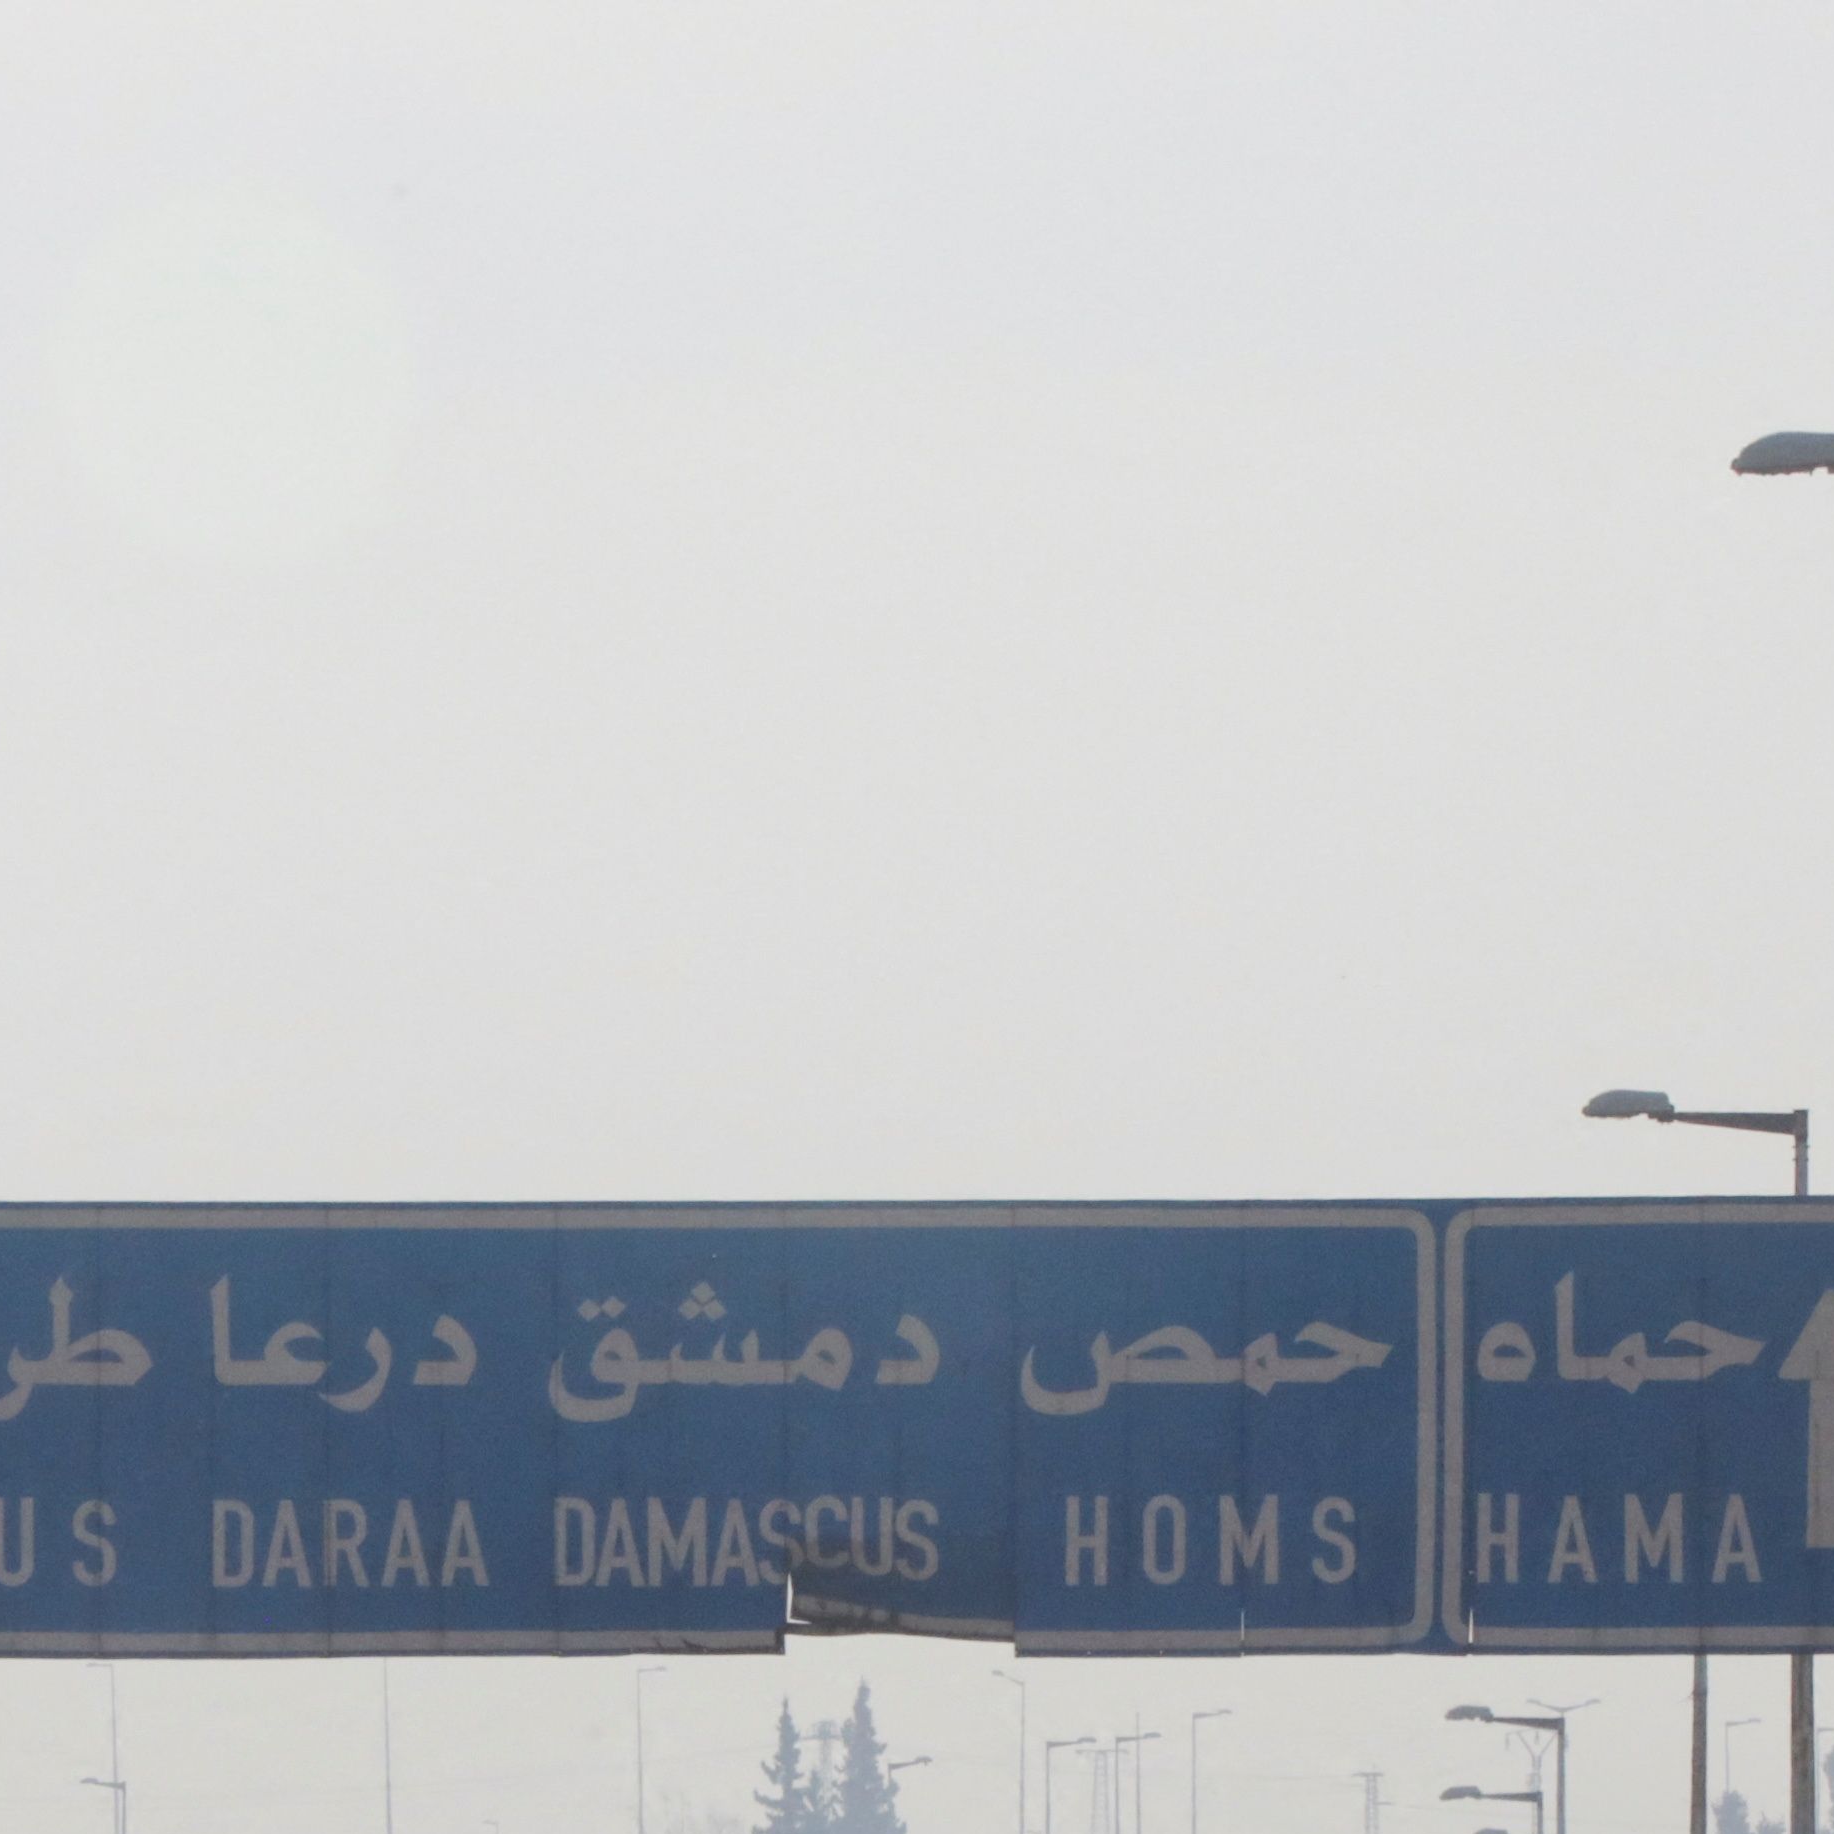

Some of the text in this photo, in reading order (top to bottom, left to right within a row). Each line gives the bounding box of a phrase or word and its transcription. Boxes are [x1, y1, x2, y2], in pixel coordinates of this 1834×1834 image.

[209, 1274, 479, 1413] درعا
[548, 1280, 942, 1423] دمشق
[1020, 1316, 1392, 1416] حمص
[1476, 1271, 1766, 1394] حماه
[211, 1496, 490, 1589] DARAA
[554, 1494, 940, 1588] DAMASCUS
[1064, 1492, 1357, 1587] HOMS
[1475, 1491, 1763, 1586] HAMA
